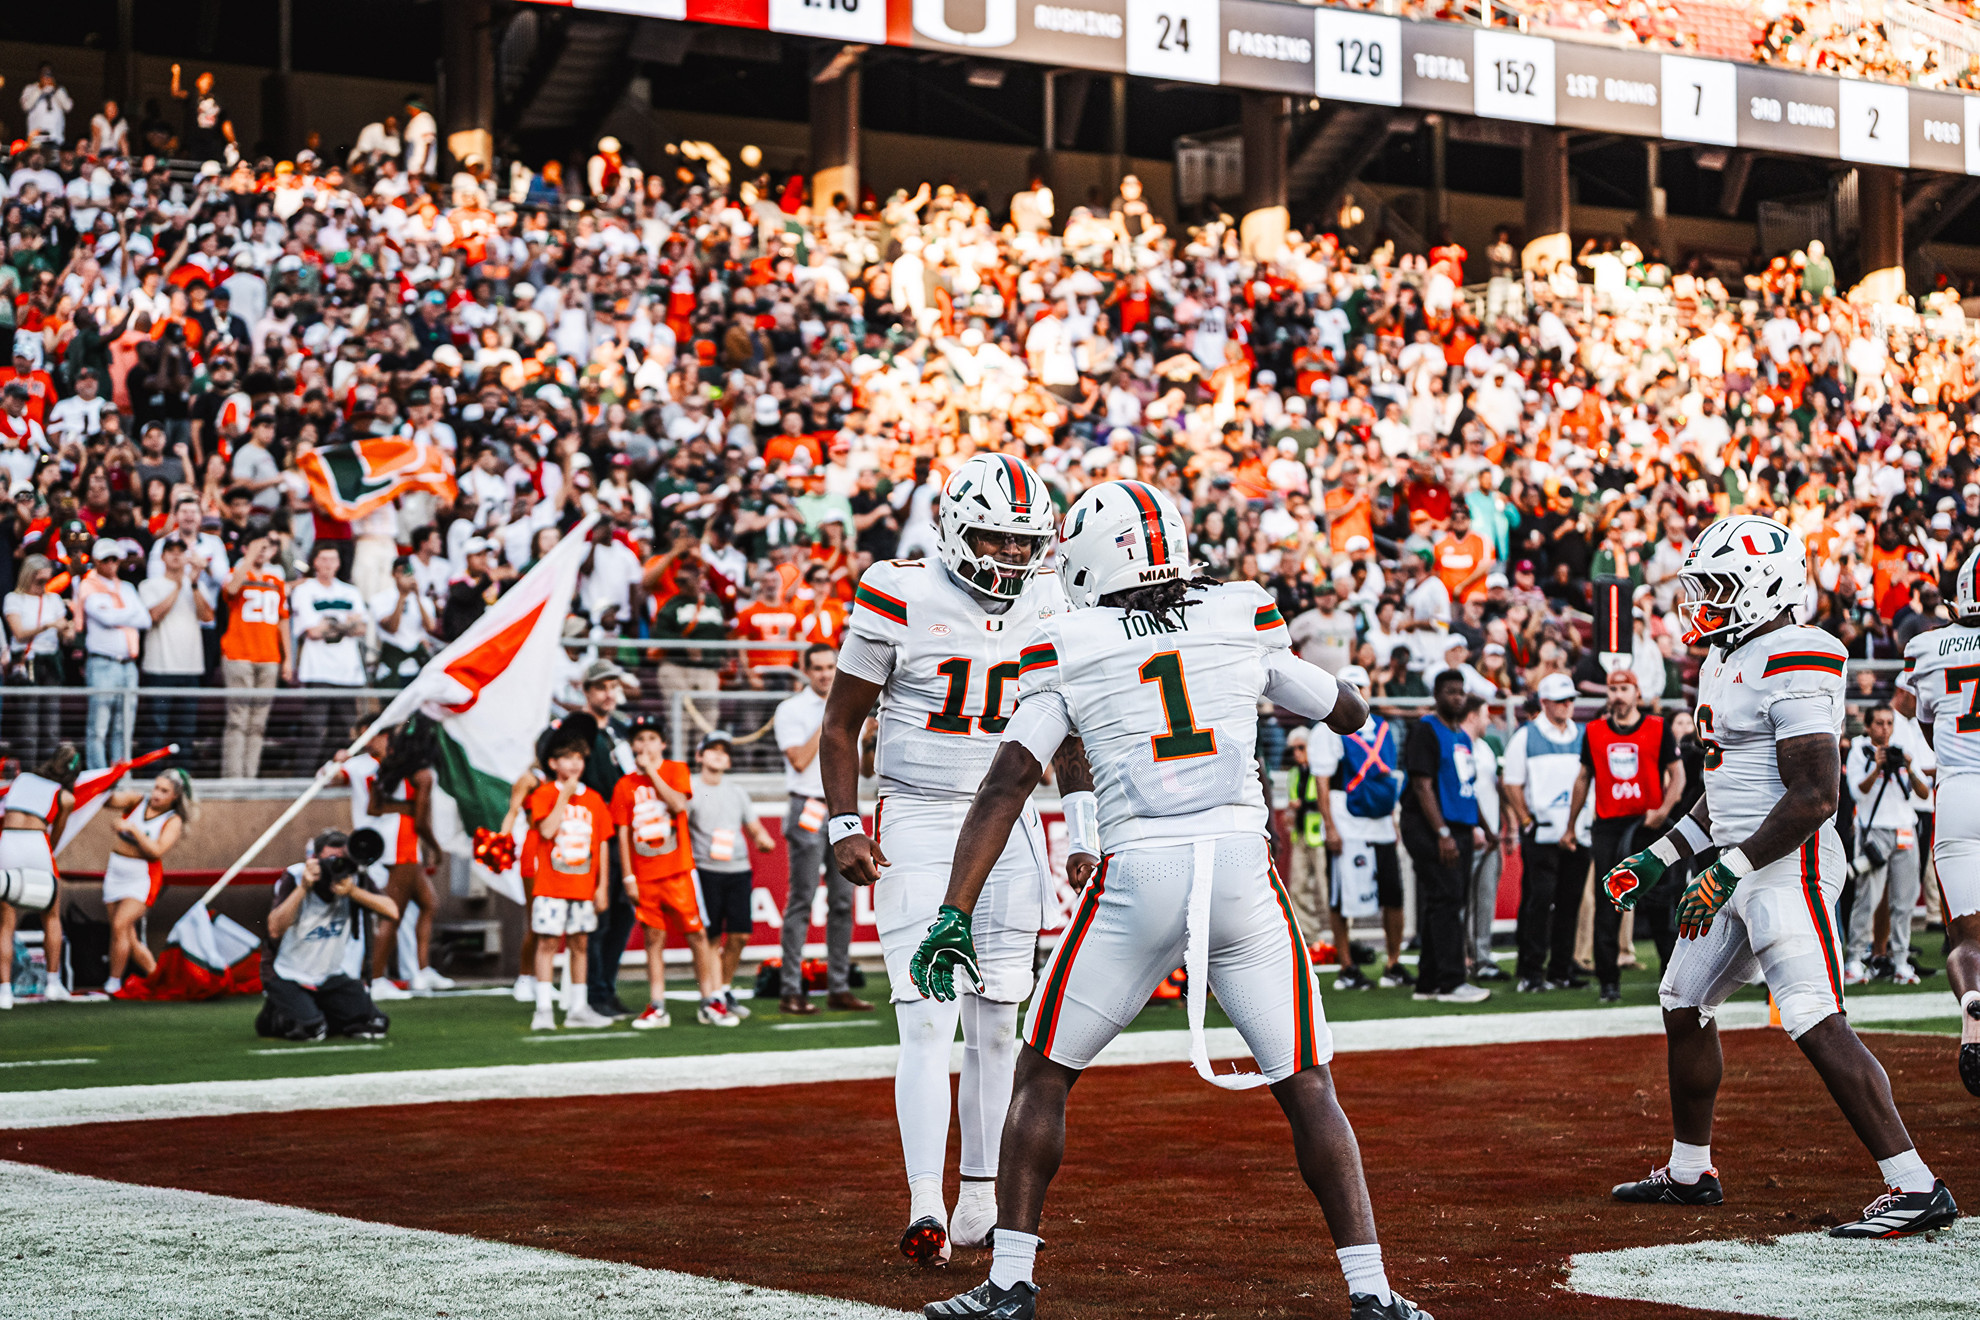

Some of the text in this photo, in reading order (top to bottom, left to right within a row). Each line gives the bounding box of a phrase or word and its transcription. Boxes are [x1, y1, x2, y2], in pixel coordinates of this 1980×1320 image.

[1034, 5, 1190, 52] RUSHING 24
[1228, 29, 1383, 77] PASSING 129
[1413, 52, 1537, 96] TOTAL 152
[1566, 74, 1702, 116] 1ST DOWNS 7
[1750, 97, 1880, 139] 3RD DOWNS 2
[1924, 119, 1960, 145] POSS
[1012, 515, 1031, 523] ACC
[1127, 548, 1135, 560] 1
[1741, 532, 1784, 556] U
[1138, 567, 1179, 583] MIAMI
[986, 620, 1003, 631] U
[926, 657, 1021, 735] 10
[1138, 650, 1218, 762] 1
